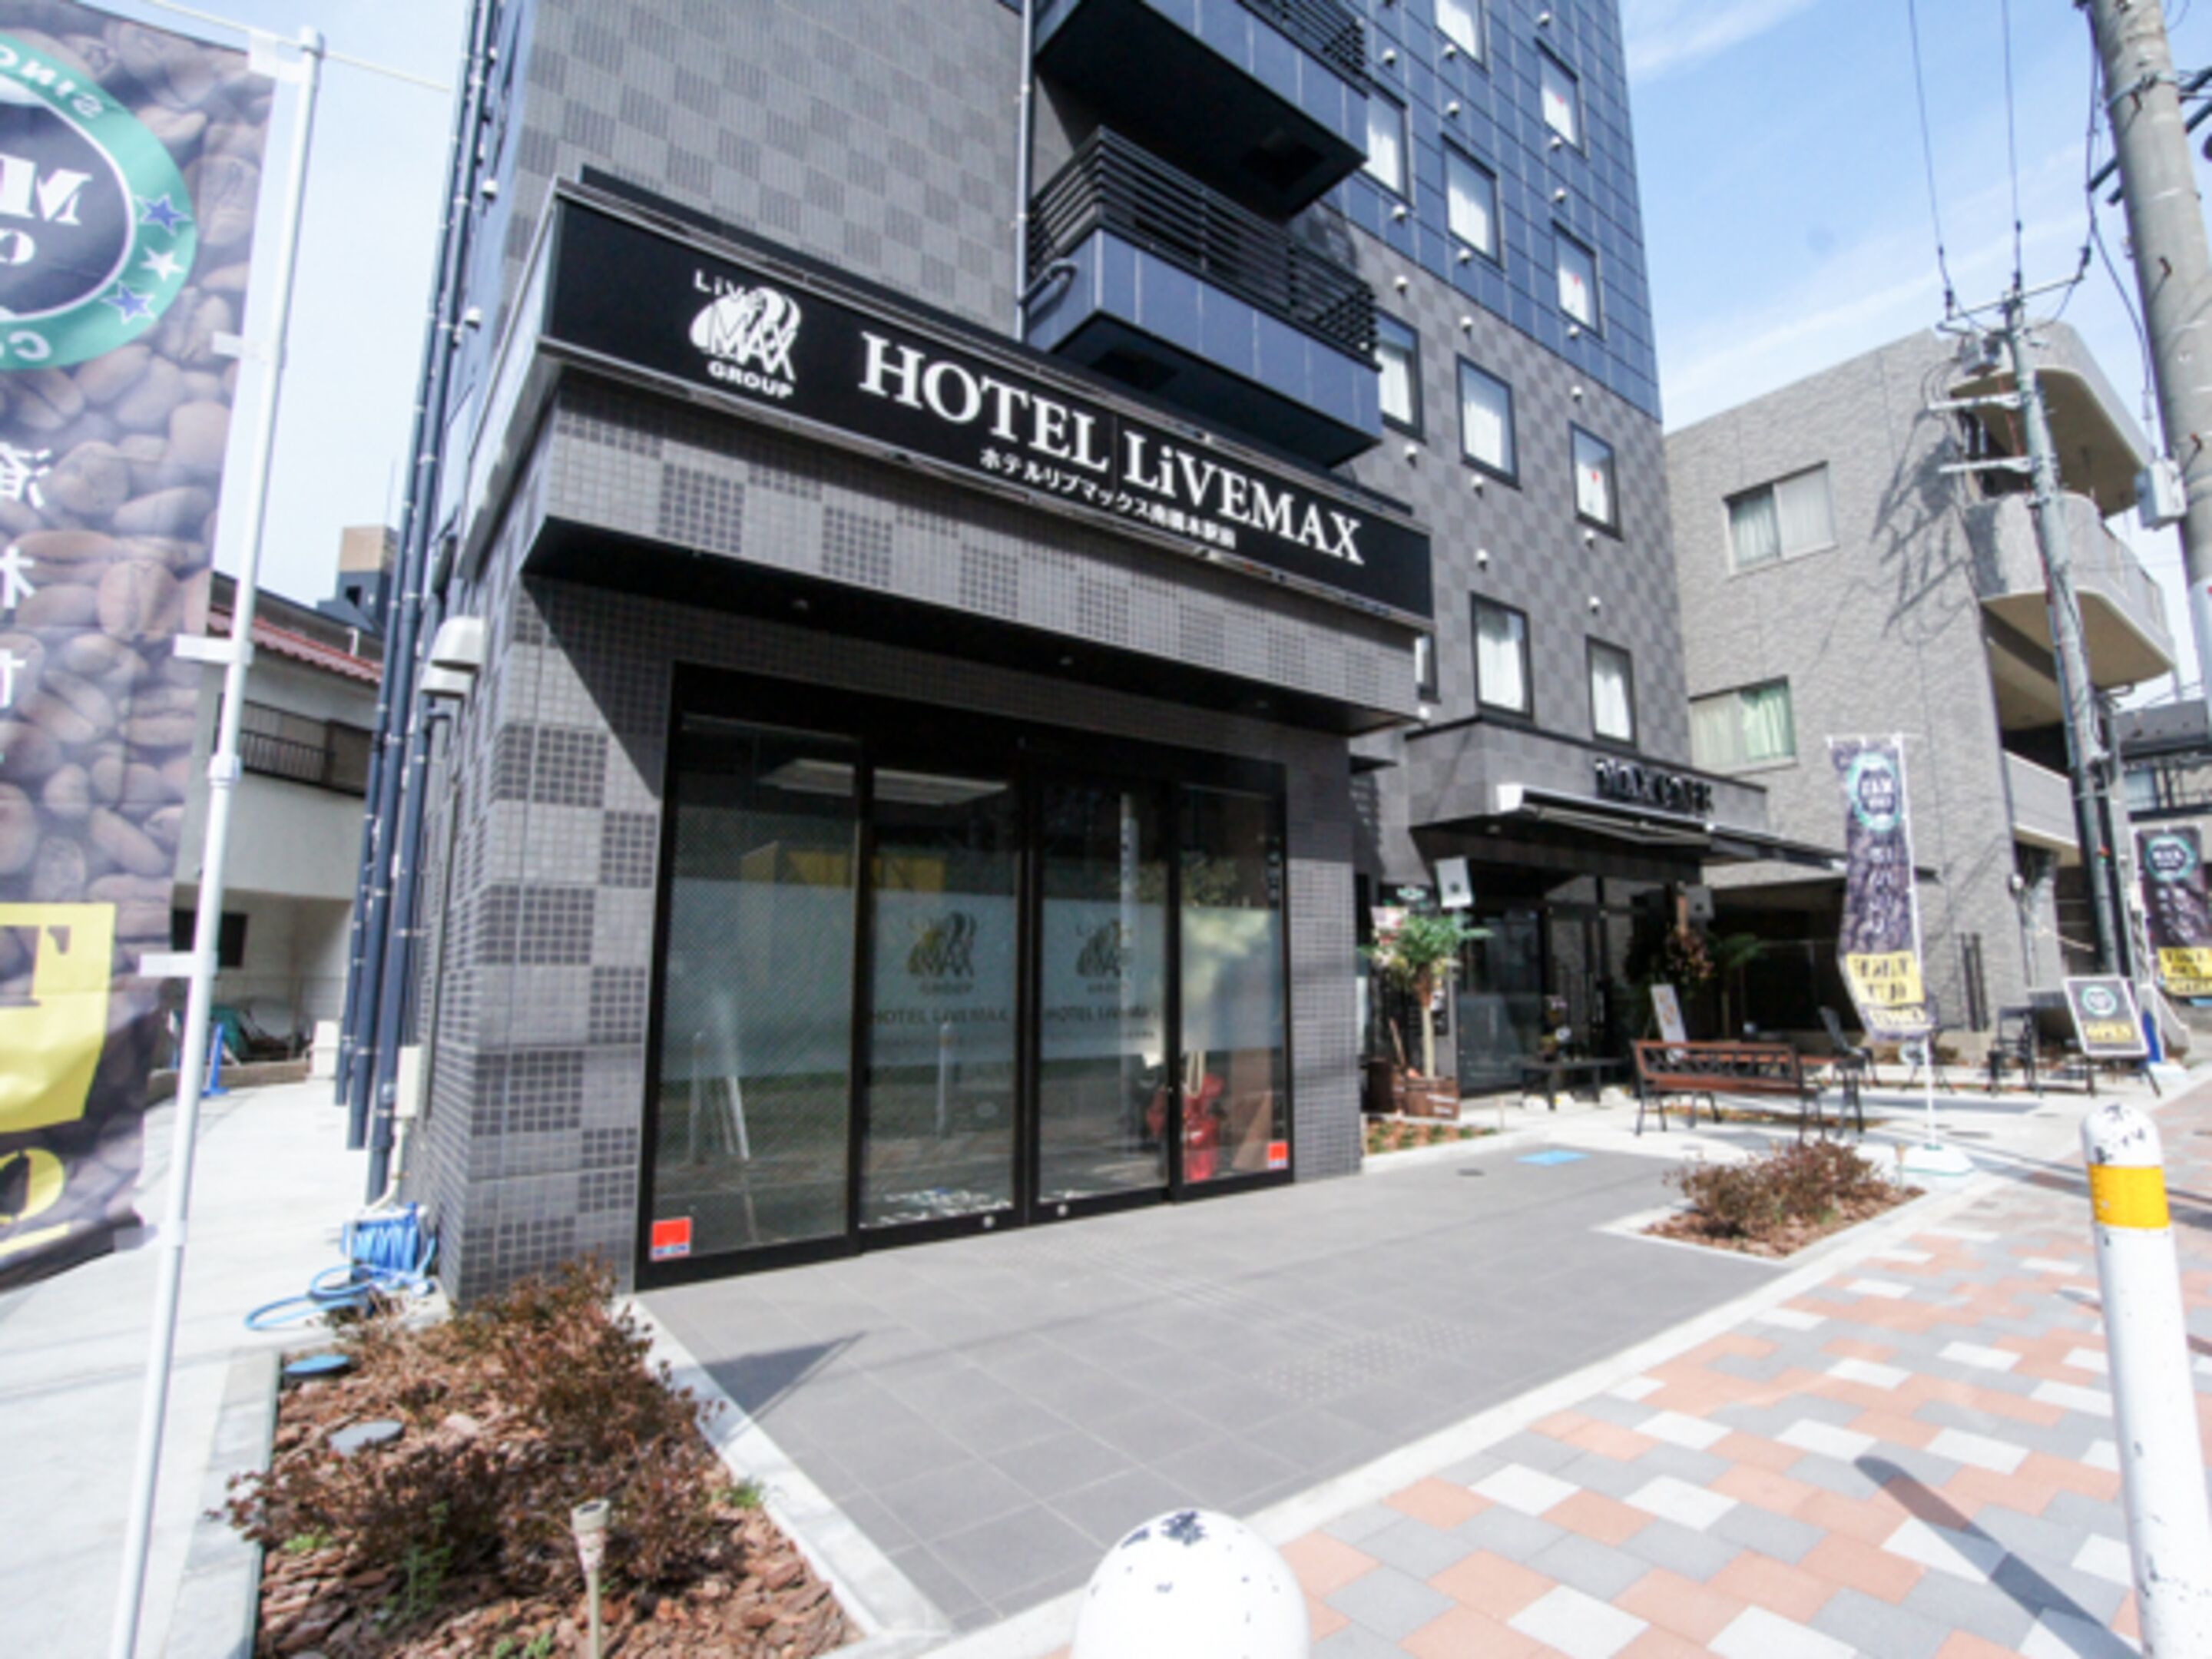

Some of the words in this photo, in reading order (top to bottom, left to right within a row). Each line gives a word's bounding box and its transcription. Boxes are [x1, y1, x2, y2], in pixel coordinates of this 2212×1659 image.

[707, 306, 797, 382] MAX
[707, 359, 794, 399] GROUP
[858, 330, 1109, 473] HOTEL
[1124, 429, 1365, 565] LiVEMAX
